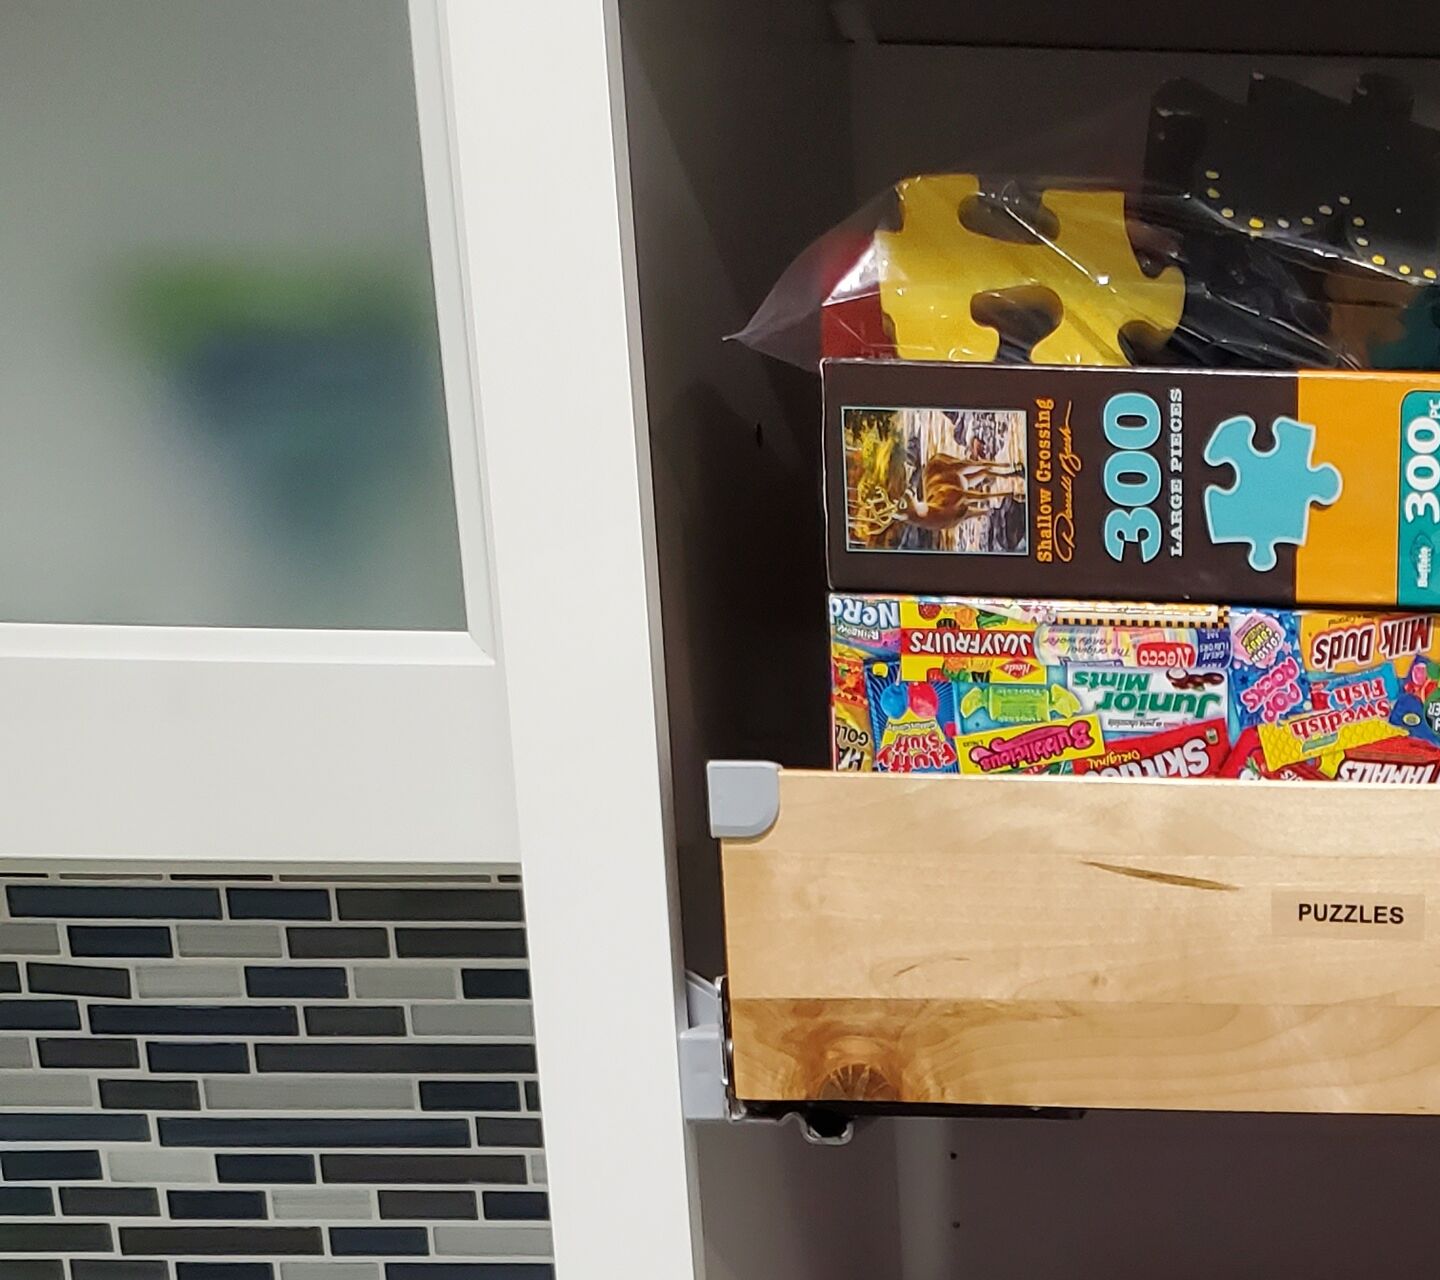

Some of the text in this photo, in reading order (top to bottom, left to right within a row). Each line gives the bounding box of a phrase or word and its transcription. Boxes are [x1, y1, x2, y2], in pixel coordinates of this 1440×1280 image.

[1035, 398, 1055, 563] Shallow Crossing
[1103, 391, 1162, 563] 300
[1169, 387, 1183, 557] LARGE PIECES
[909, 629, 1032, 657] JUJYFRUITS
[1312, 627, 1374, 669] Duds
[1379, 616, 1432, 659] Milk
[1139, 647, 1191, 668] Necco
[1071, 671, 1150, 692] Mints
[1335, 680, 1386, 706] Fish
[1095, 693, 1221, 719] Junior
[1262, 682, 1302, 723] POP
[1290, 700, 1390, 739] Swedish
[876, 743, 957, 774] Fluffy
[894, 733, 940, 754] Stuff
[979, 721, 1094, 772] Bubblicious
[1298, 903, 1404, 924] PUZZLES
